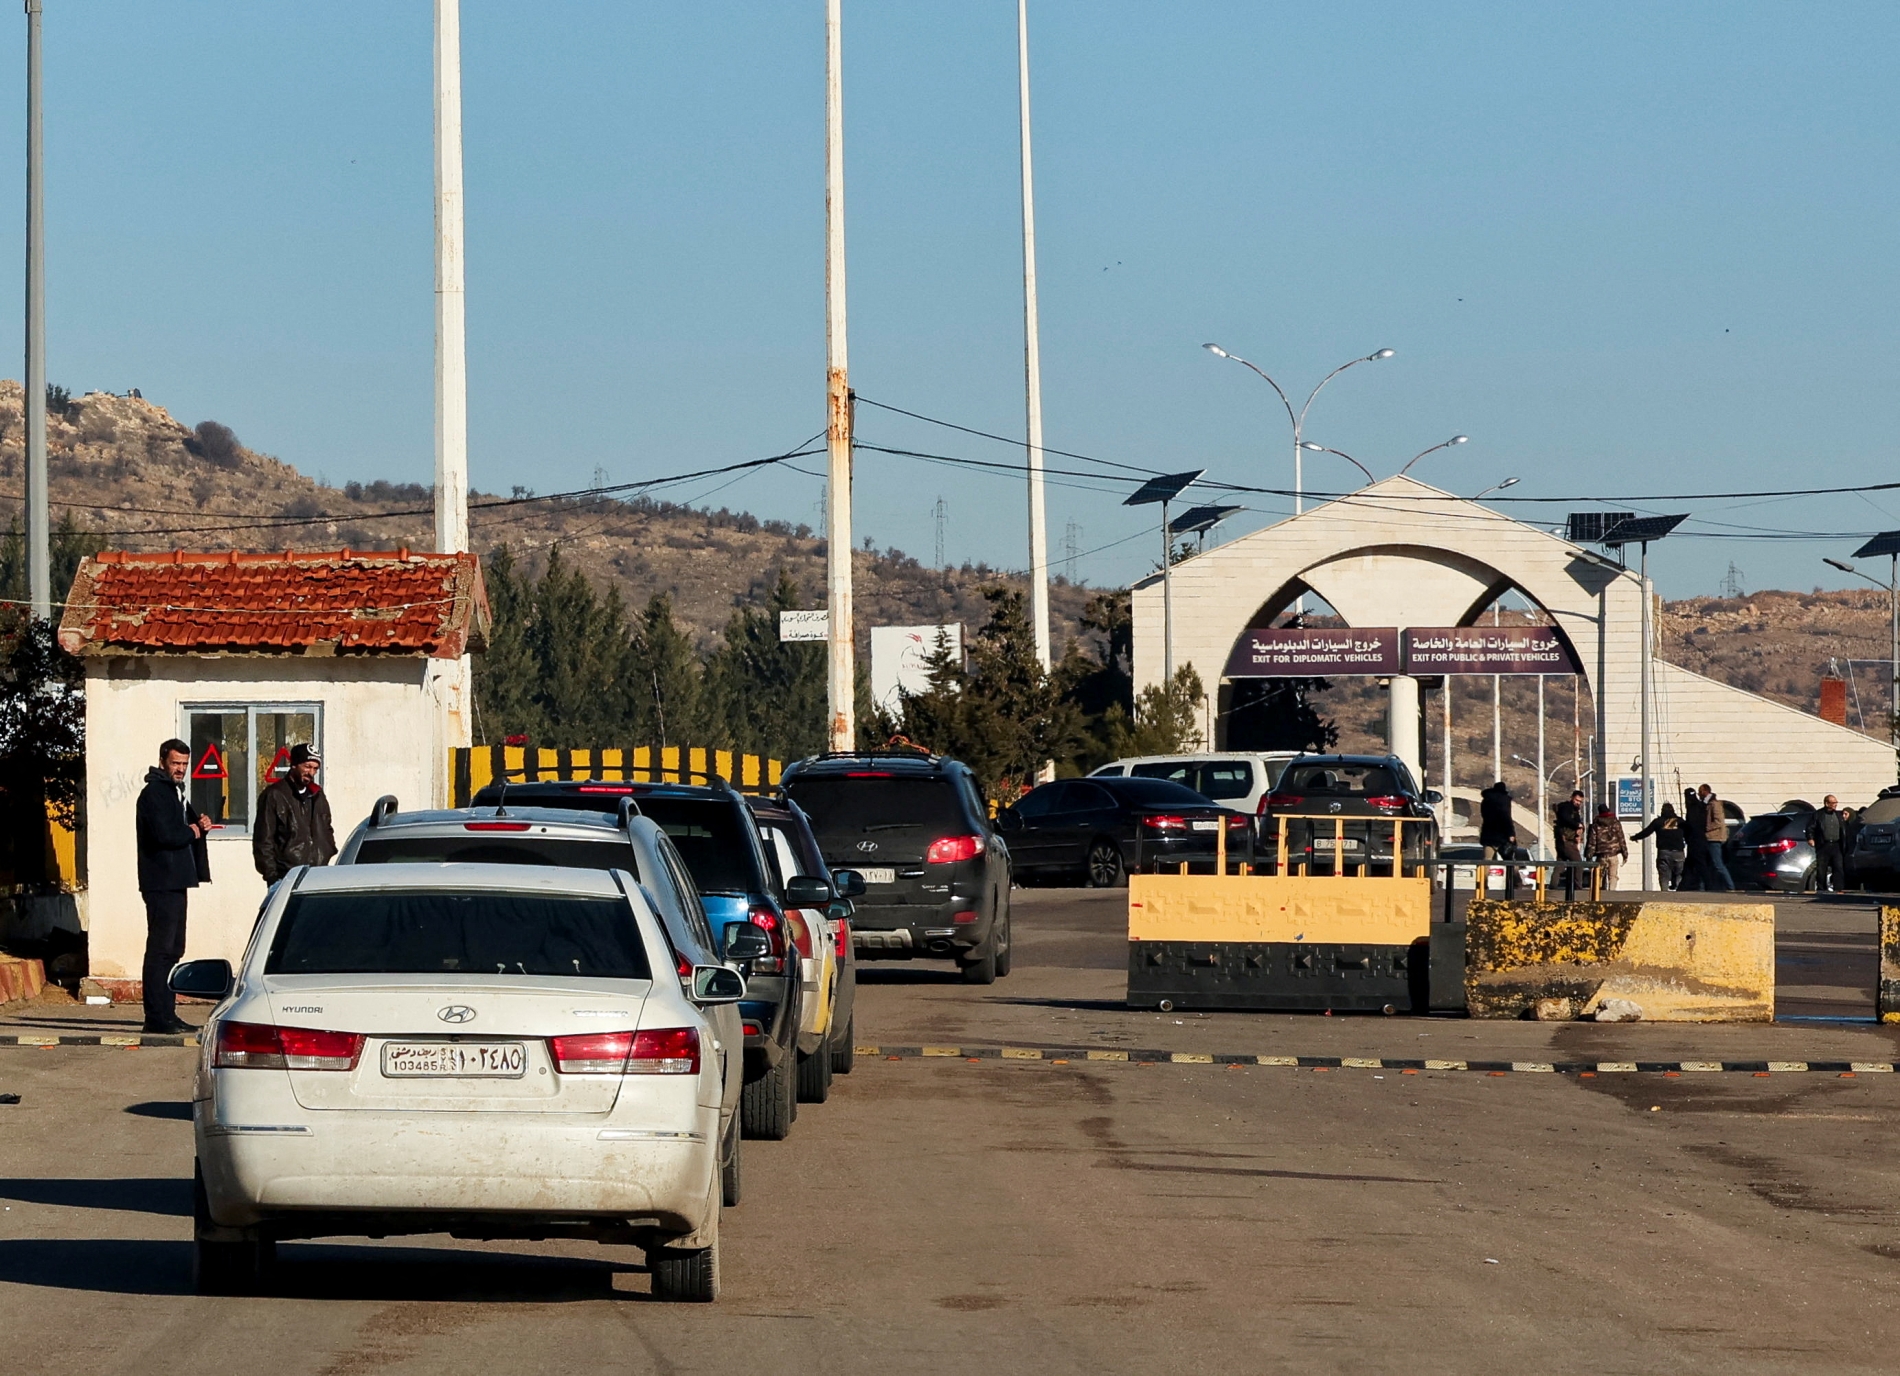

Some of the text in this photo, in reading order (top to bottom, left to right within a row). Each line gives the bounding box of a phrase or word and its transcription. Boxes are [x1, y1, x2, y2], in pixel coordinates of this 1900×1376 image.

[1252, 637, 1382, 653] خروج السيارات الدبلوماسية
[1412, 637, 1559, 651] خروج السيارات العامة والخاصة
[1252, 653, 1383, 663] EXIT FOR DIPLOMATIC VEHICLES
[1412, 652, 1560, 662] EXIT FOR PUBLIC & PRIVATE VEHICLES
[282, 1006, 324, 1014] HYUNDAI
[460, 1046, 521, 1071] ١٠٣٤٨٥
[394, 1060, 438, 1071] 103485
